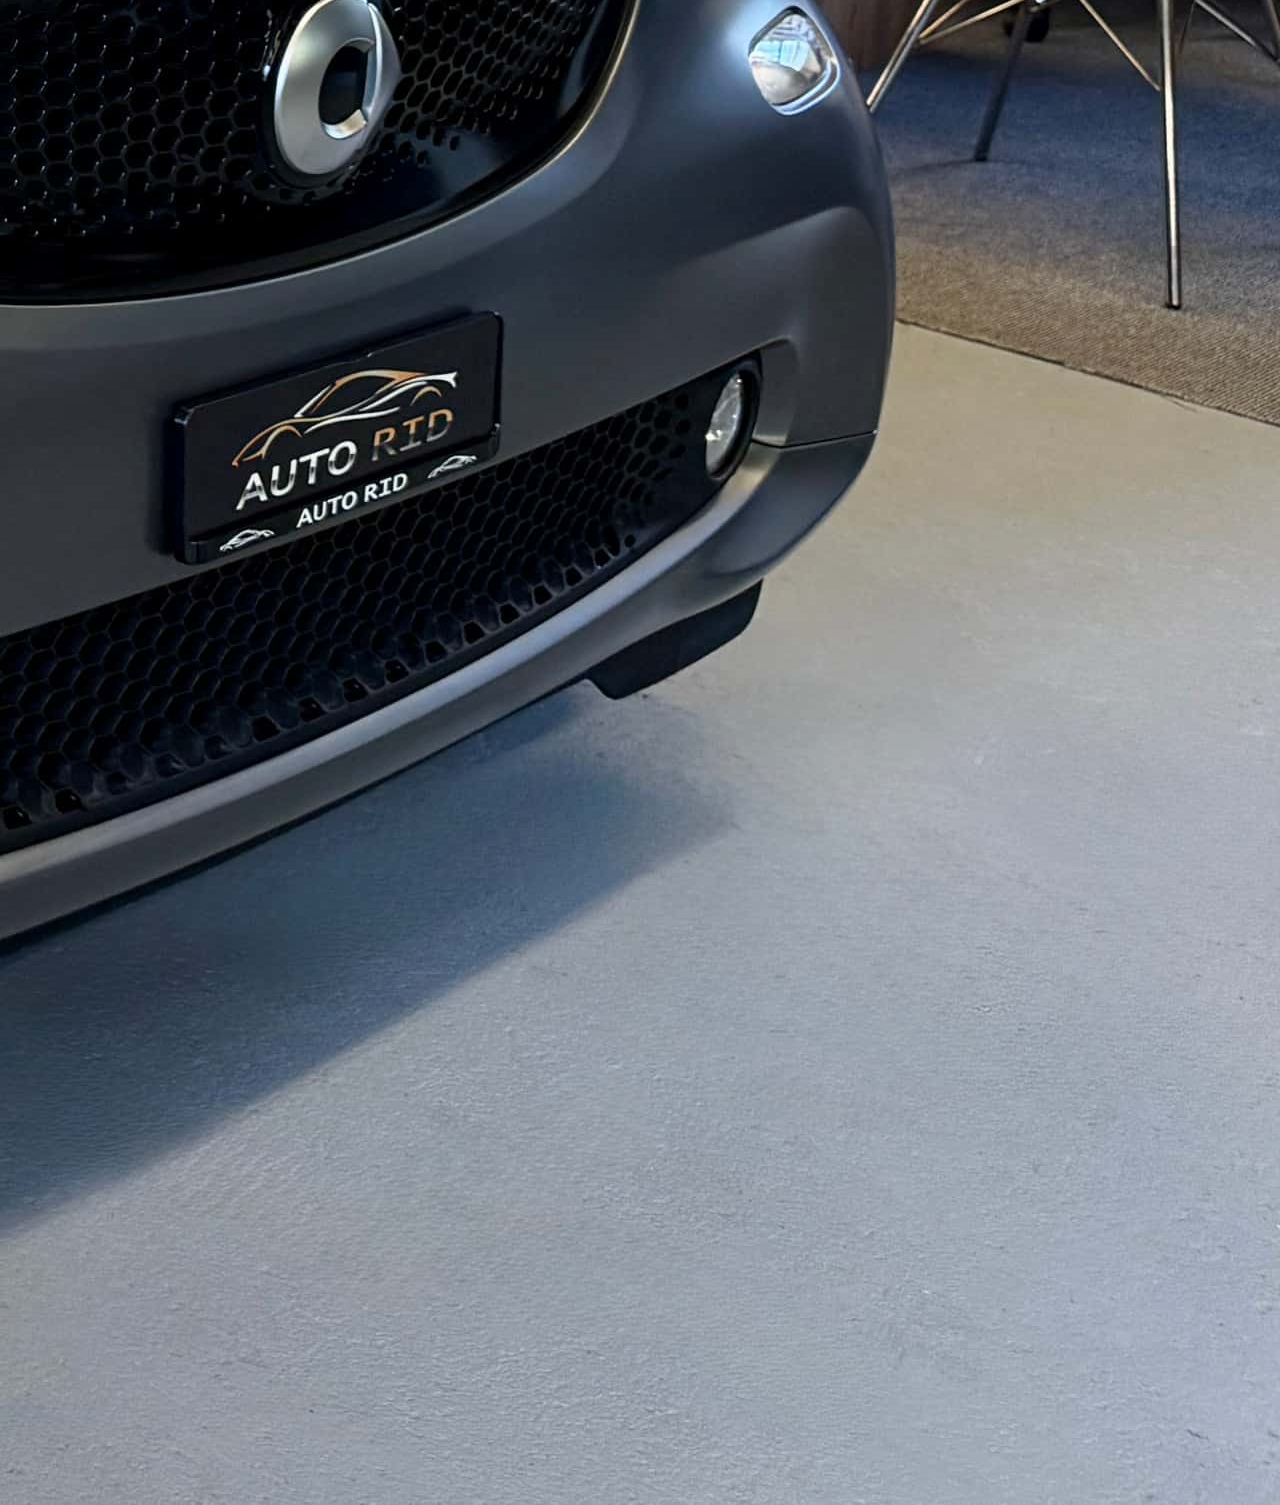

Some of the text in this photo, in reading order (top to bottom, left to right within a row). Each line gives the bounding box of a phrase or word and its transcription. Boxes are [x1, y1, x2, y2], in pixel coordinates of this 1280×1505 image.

[235, 408, 454, 510] AUTO RID
[295, 472, 409, 528] AUTO RID
